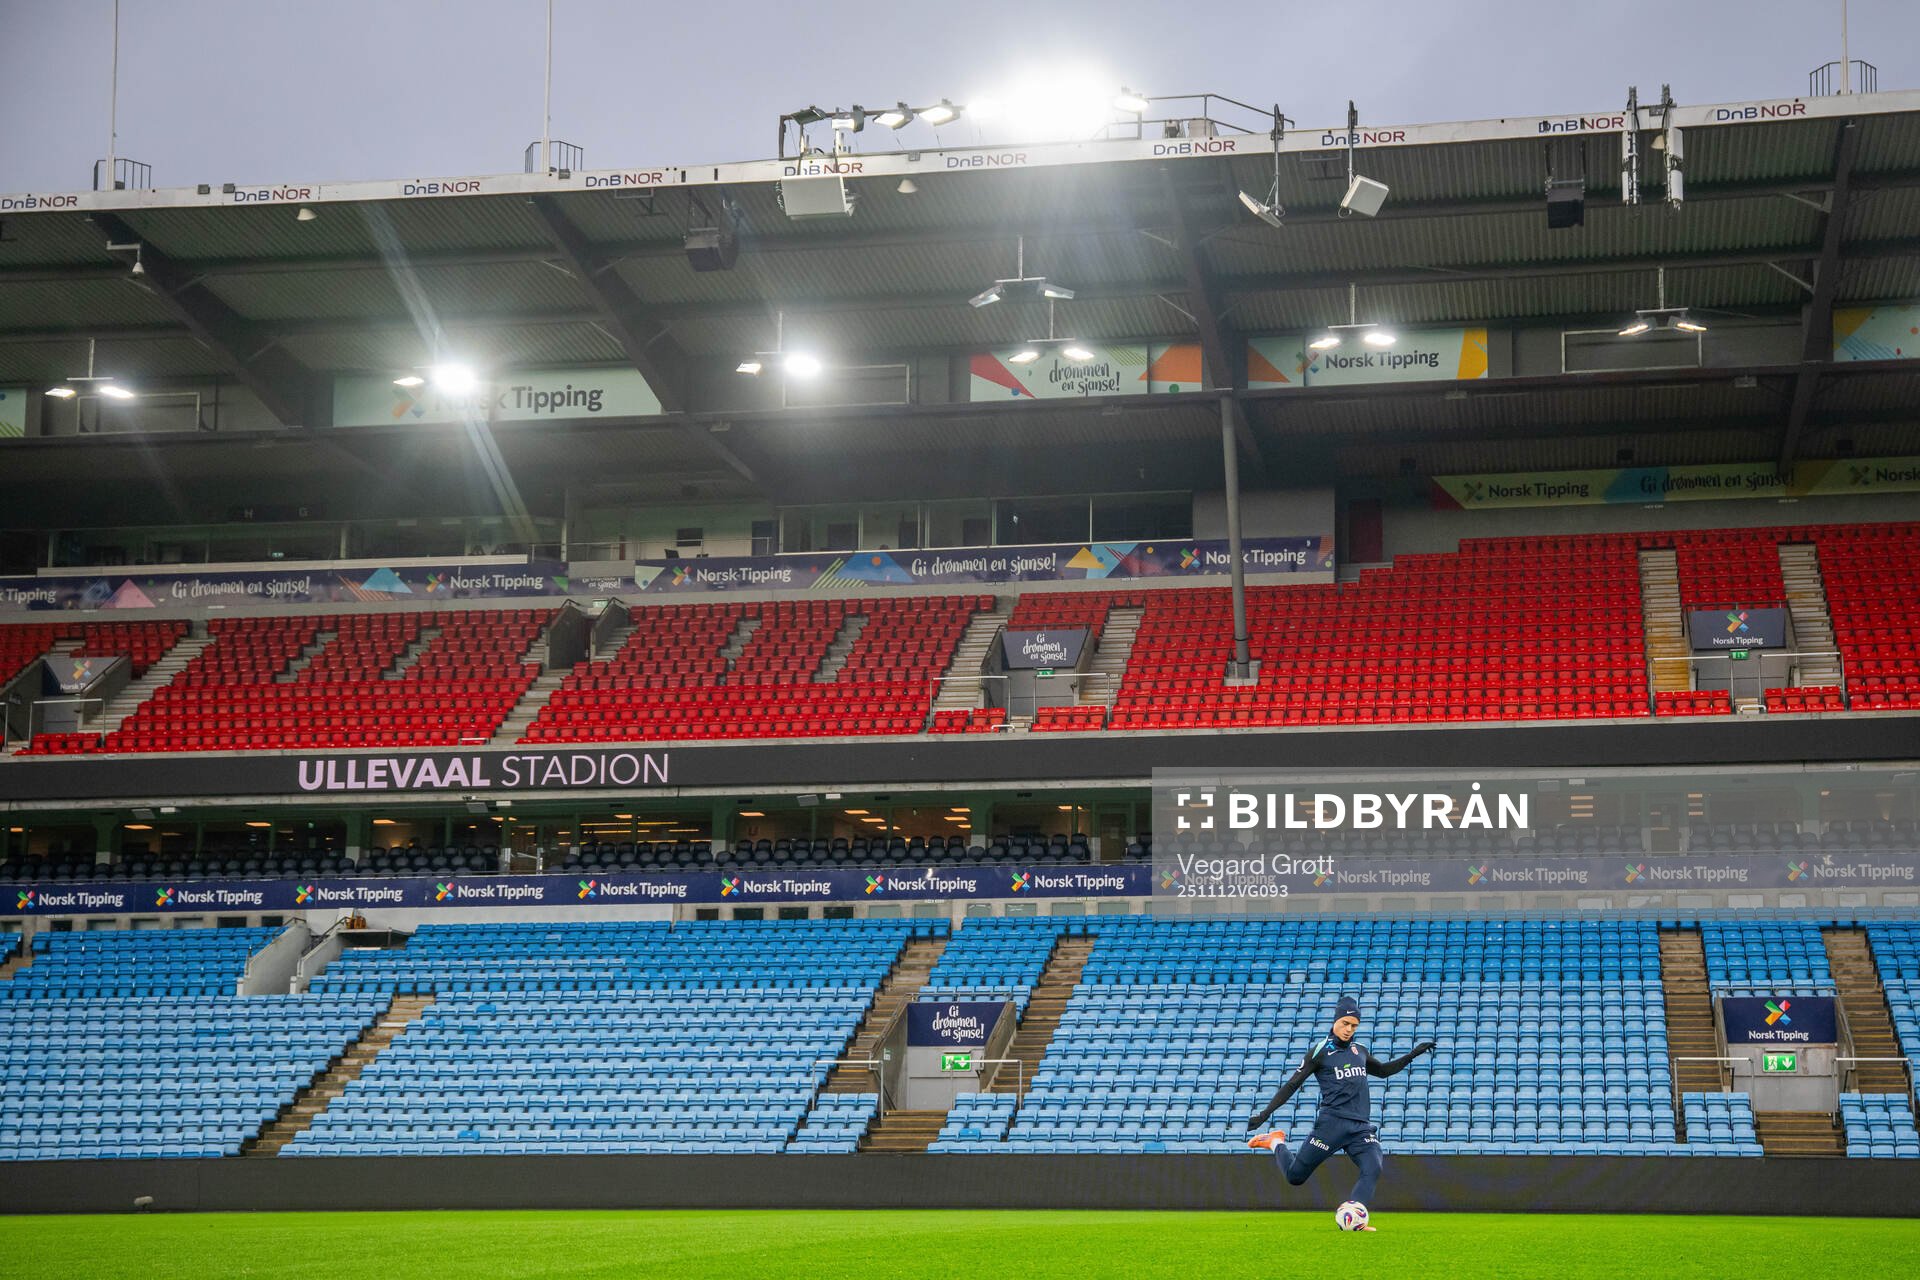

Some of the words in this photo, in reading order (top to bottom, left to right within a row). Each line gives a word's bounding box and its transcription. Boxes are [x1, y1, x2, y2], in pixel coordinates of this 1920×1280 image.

[1717, 108, 1758, 121] DnB
[1761, 103, 1806, 117] NOR
[1538, 118, 1578, 133] DnB
[1581, 116, 1624, 131] NOR
[1322, 132, 1360, 145] DnB
[1364, 131, 1405, 143] NOR
[1154, 143, 1191, 155] DnB
[1195, 140, 1235, 153] NOR
[947, 156, 983, 168] DnB
[987, 153, 1027, 165] NOR
[586, 175, 621, 187] DnB
[624, 172, 663, 185] NOR
[234, 189, 270, 202] DnB
[272, 188, 310, 201] NOR
[404, 183, 439, 195] DnB
[442, 181, 480, 193] NOR
[1, 198, 37, 209] DnB
[40, 196, 77, 208] NOR
[1325, 352, 1373, 370] Norsk
[1377, 350, 1439, 370] Tipping
[1050, 359, 1110, 384] drømmen
[1062, 381, 1075, 391] en
[1078, 371, 1120, 398] sjanse!
[512, 384, 603, 413] Tipping
[1725, 474, 1742, 488] en
[1488, 483, 1531, 498] Norsk
[1533, 481, 1589, 498] Tipping
[912, 558, 926, 576] Gi
[931, 554, 987, 576] drømmen
[990, 557, 1007, 572] en
[1010, 552, 1056, 575] sjanse!
[1205, 551, 1249, 565] Nork
[1251, 548, 1306, 566] Tipping
[450, 574, 490, 590] Norsk
[492, 573, 544, 590] Tipping
[697, 568, 738, 583] Norsk
[739, 566, 792, 584] Tipping
[172, 580, 188, 599] Gi
[191, 578, 245, 598] drømmen
[247, 578, 263, 594] en
[265, 576, 311, 597] sjanse!
[6, 587, 56, 605] Tipping
[1023, 638, 1061, 655] drømmen
[1036, 633, 1046, 644] Gi
[1713, 637, 1735, 645] Norsk
[1736, 636, 1763, 646] Tipping
[1040, 647, 1067, 665] sjanse!
[299, 756, 491, 790] ULLEVAAL
[501, 753, 669, 786] STADION
[1338, 870, 1377, 883] Norsk
[1379, 869, 1430, 886] Tipping
[1492, 868, 1533, 881] Norsk
[1535, 867, 1588, 883] Tipping
[1650, 866, 1692, 879] Norsk
[1694, 865, 1748, 881] Tipping
[1813, 863, 1856, 878] Norsk
[1858, 862, 1914, 880] Tipping
[743, 880, 781, 893] Norsk
[783, 878, 831, 895] Tipping
[888, 877, 926, 891] Norsk
[928, 875, 976, 892] Tipping
[1035, 875, 1073, 888] Norsk
[1075, 874, 1124, 890] Tipping
[1185, 873, 1224, 886] Norsk
[1226, 872, 1276, 887] Tipping
[178, 890, 215, 903] Norsk
[216, 889, 263, 904] Tipping
[318, 887, 355, 900] Norsk
[356, 886, 403, 901] Tipping
[458, 884, 495, 898] Norsk
[496, 883, 544, 899] Tipping
[600, 882, 638, 895] Norsk
[640, 881, 687, 897] Tipping
[39, 893, 75, 906] Norsk
[77, 891, 124, 906] Tipping
[948, 1005, 959, 1017] Gi
[932, 1012, 977, 1031] drømmen
[941, 1029, 951, 1037] en
[953, 1023, 985, 1043] sjanse!
[1748, 1030, 1774, 1040] Norsk
[1775, 1030, 1809, 1041] Tipping
[1334, 1065, 1366, 1080] bama
